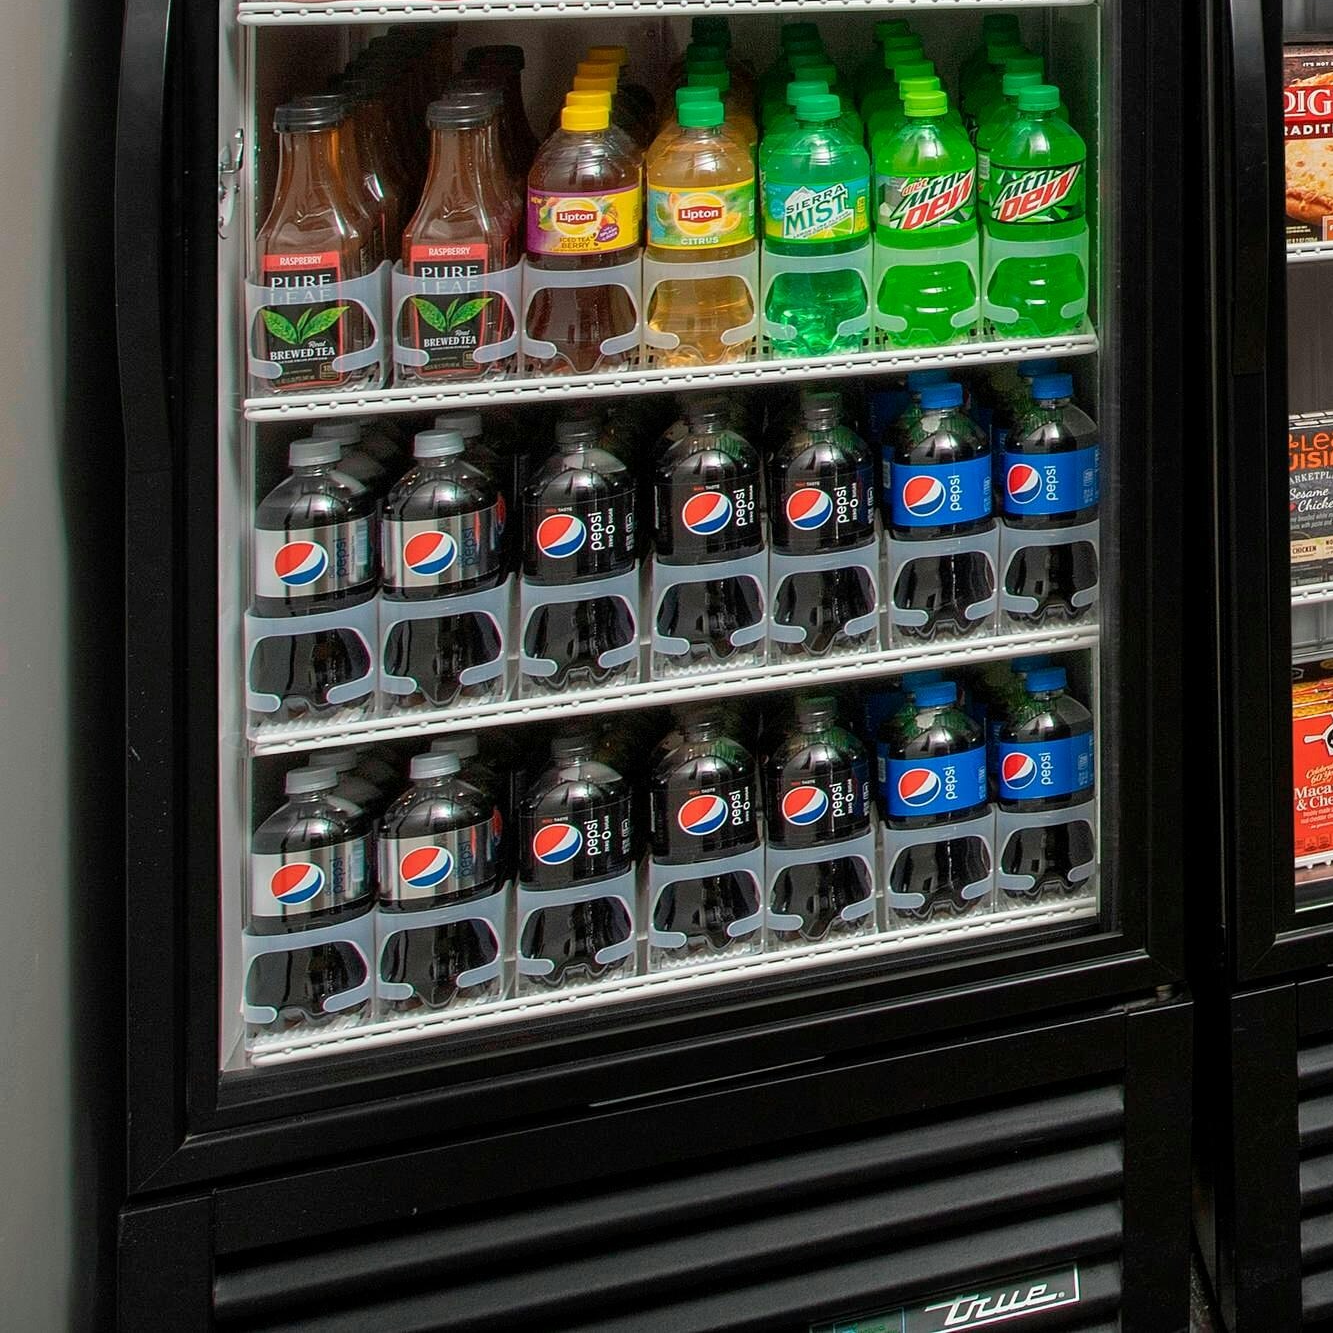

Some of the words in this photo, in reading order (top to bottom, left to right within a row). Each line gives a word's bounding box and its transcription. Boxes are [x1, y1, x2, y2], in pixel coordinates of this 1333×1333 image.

[786, 184, 844, 213] SIERRA
[559, 211, 594, 224] Lipton
[681, 207, 719, 220] Lipton
[784, 194, 849, 233] MIST
[681, 237, 719, 245] CITRUS
[280, 256, 322, 266] RASPBERRY
[271, 273, 332, 291] PURE
[270, 348, 313, 361] BREWED
[314, 346, 335, 357] TEA
[949, 474, 961, 512] pepsi
[1045, 465, 1057, 502] pepsi
[734, 489, 746, 527] pepsi
[589, 511, 604, 551] pepsi
[945, 764, 957, 801] pepsi
[1040, 751, 1052, 786] pepsi
[1296, 799, 1307, 811] &
